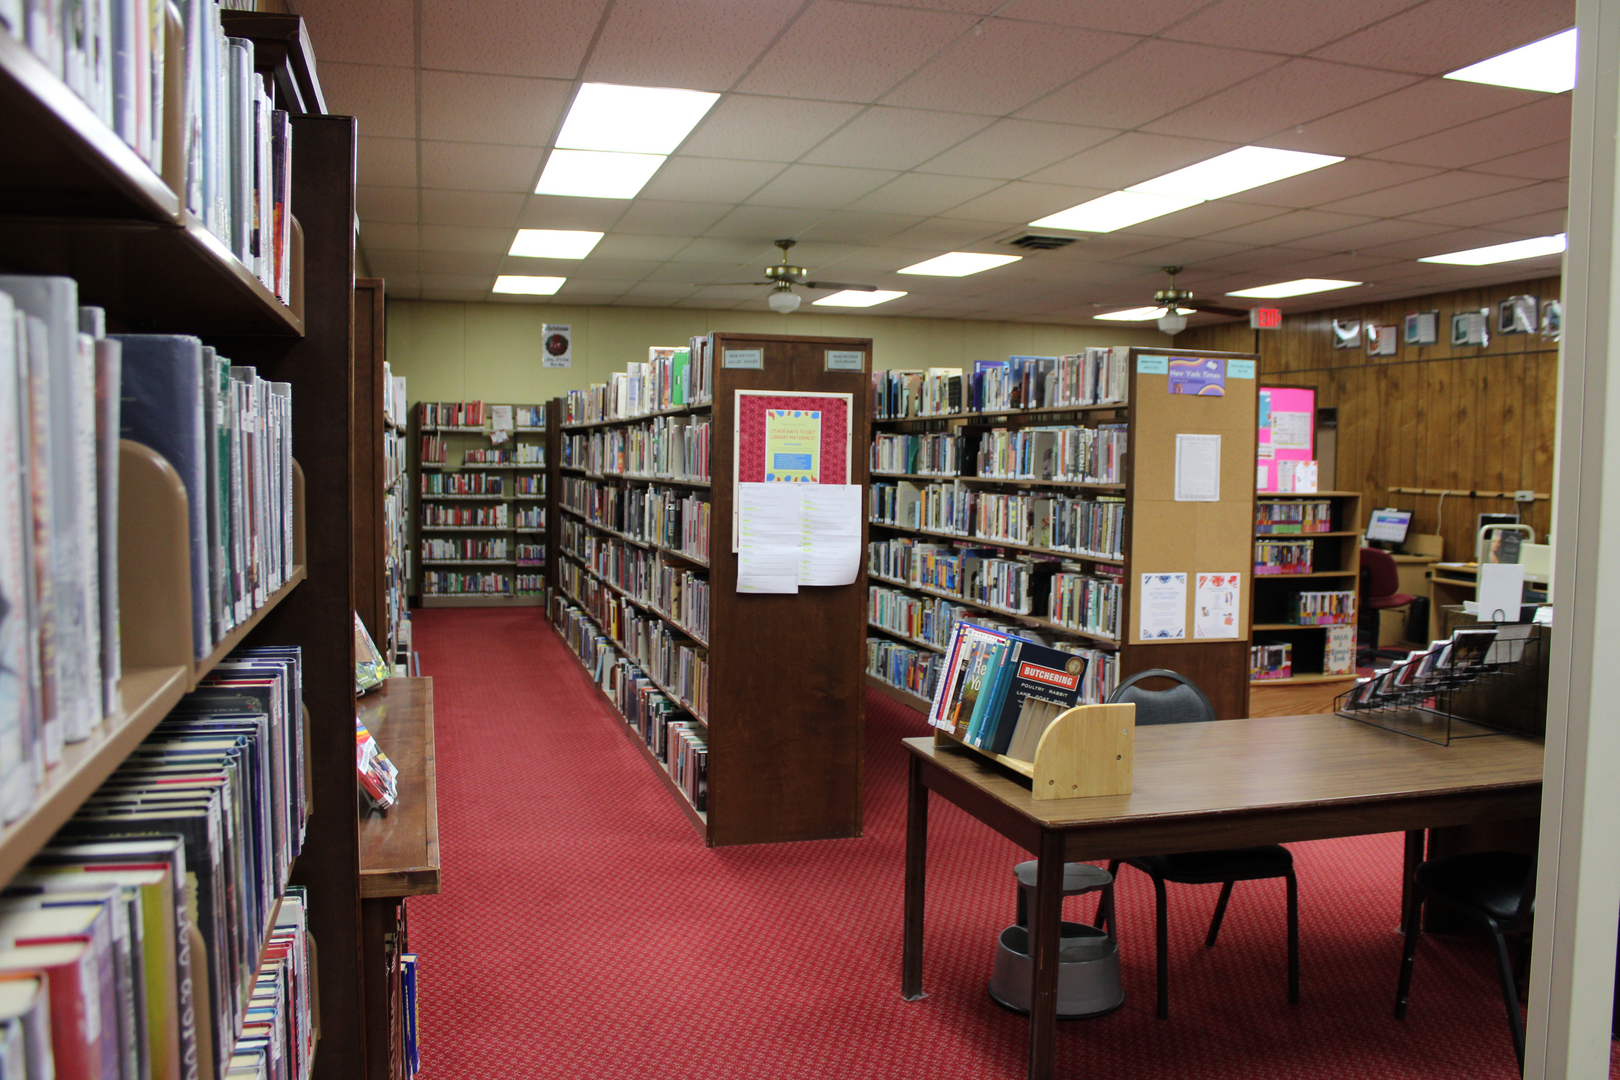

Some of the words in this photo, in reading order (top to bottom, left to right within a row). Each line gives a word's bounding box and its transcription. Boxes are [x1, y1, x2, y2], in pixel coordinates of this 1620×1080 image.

[1259, 308, 1279, 327] EXIT
[1203, 371, 1221, 379] Times
[1024, 666, 1073, 686] BUTCHERING
[1021, 682, 1045, 692] POULTRY
[1048, 689, 1068, 697] RABBIT
